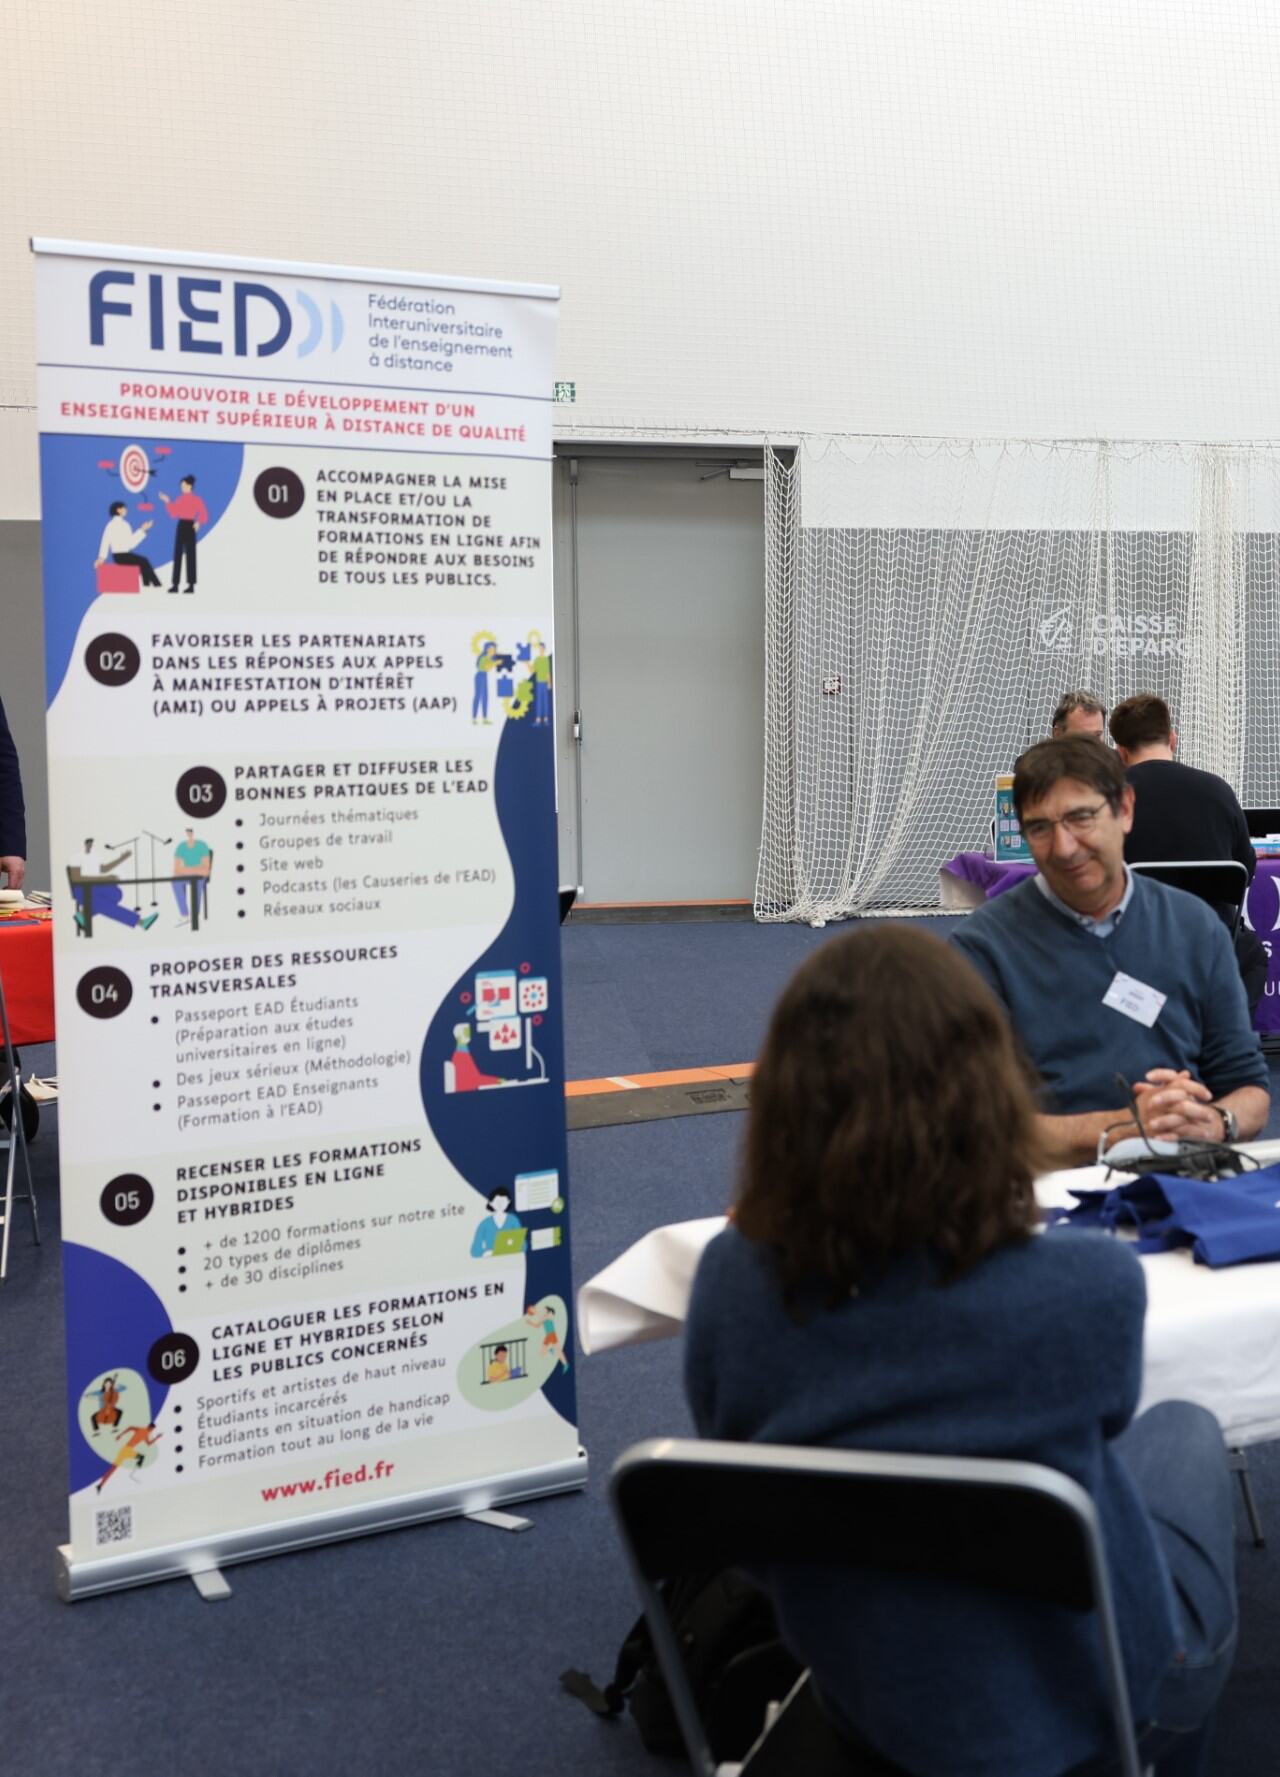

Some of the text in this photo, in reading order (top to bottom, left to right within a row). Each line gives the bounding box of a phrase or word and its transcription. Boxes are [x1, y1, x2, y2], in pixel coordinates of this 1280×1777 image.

[89, 270, 292, 357] FIED
[367, 292, 455, 315] Fédération
[367, 312, 503, 339] Interuniversitaire
[367, 332, 512, 358] de l'enseignement
[368, 351, 453, 372] à distance
[119, 381, 474, 418] PROMOUVOIR LE DÉVELOPPEMENT D'UN
[59, 401, 525, 442] ENSEIGNEMENT SUPÉRIEUR À DISTANCE DE QUALITÉ
[315, 468, 506, 490] ACCOMPAGNER LA MISE
[268, 484, 289, 504] 01
[316, 488, 472, 508] EN PLACE ET/OU LA
[316, 509, 490, 528] TRANSFORMATION DE
[317, 529, 540, 549] FORMATIONS EN LIGNE AFIN
[317, 547, 534, 568] DE RÉPONDRE AUX BESOINS
[318, 569, 496, 586] DE TOUS LES PUBLICS.
[151, 633, 425, 648] FAVORISER LES PARTENARIATS
[99, 651, 126, 671] 02
[151, 651, 443, 670] DANS LES RÉPONSES AUX APPELS
[152, 671, 414, 692] À MANIFESTATION D'INTÉRÊT
[152, 693, 457, 717] (AMI) OU APPELS À PROJETS (AAP)
[233, 759, 473, 779] PARTAGER ET DIFFUSER LES
[188, 784, 214, 804] 03
[234, 778, 488, 801] BONNES PRATIQUES DE L'EAD
[258, 807, 419, 827] Journées thématiques
[259, 855, 324, 872] Site web
[149, 944, 398, 977] PROPOSER DES RESSOURCES
[91, 983, 118, 1003] 04
[149, 973, 296, 998] TRANSVERSALES
[176, 1138, 421, 1181] RECENSER LES FORMATIONS
[176, 1162, 384, 1202] DISPONIBLES EN LIGNE
[114, 1191, 140, 1211] 05
[176, 1195, 294, 1224] ET HYBRIDES
[161, 1348, 186, 1369] 06
[260, 1459, 394, 1502] www.fied.fr
